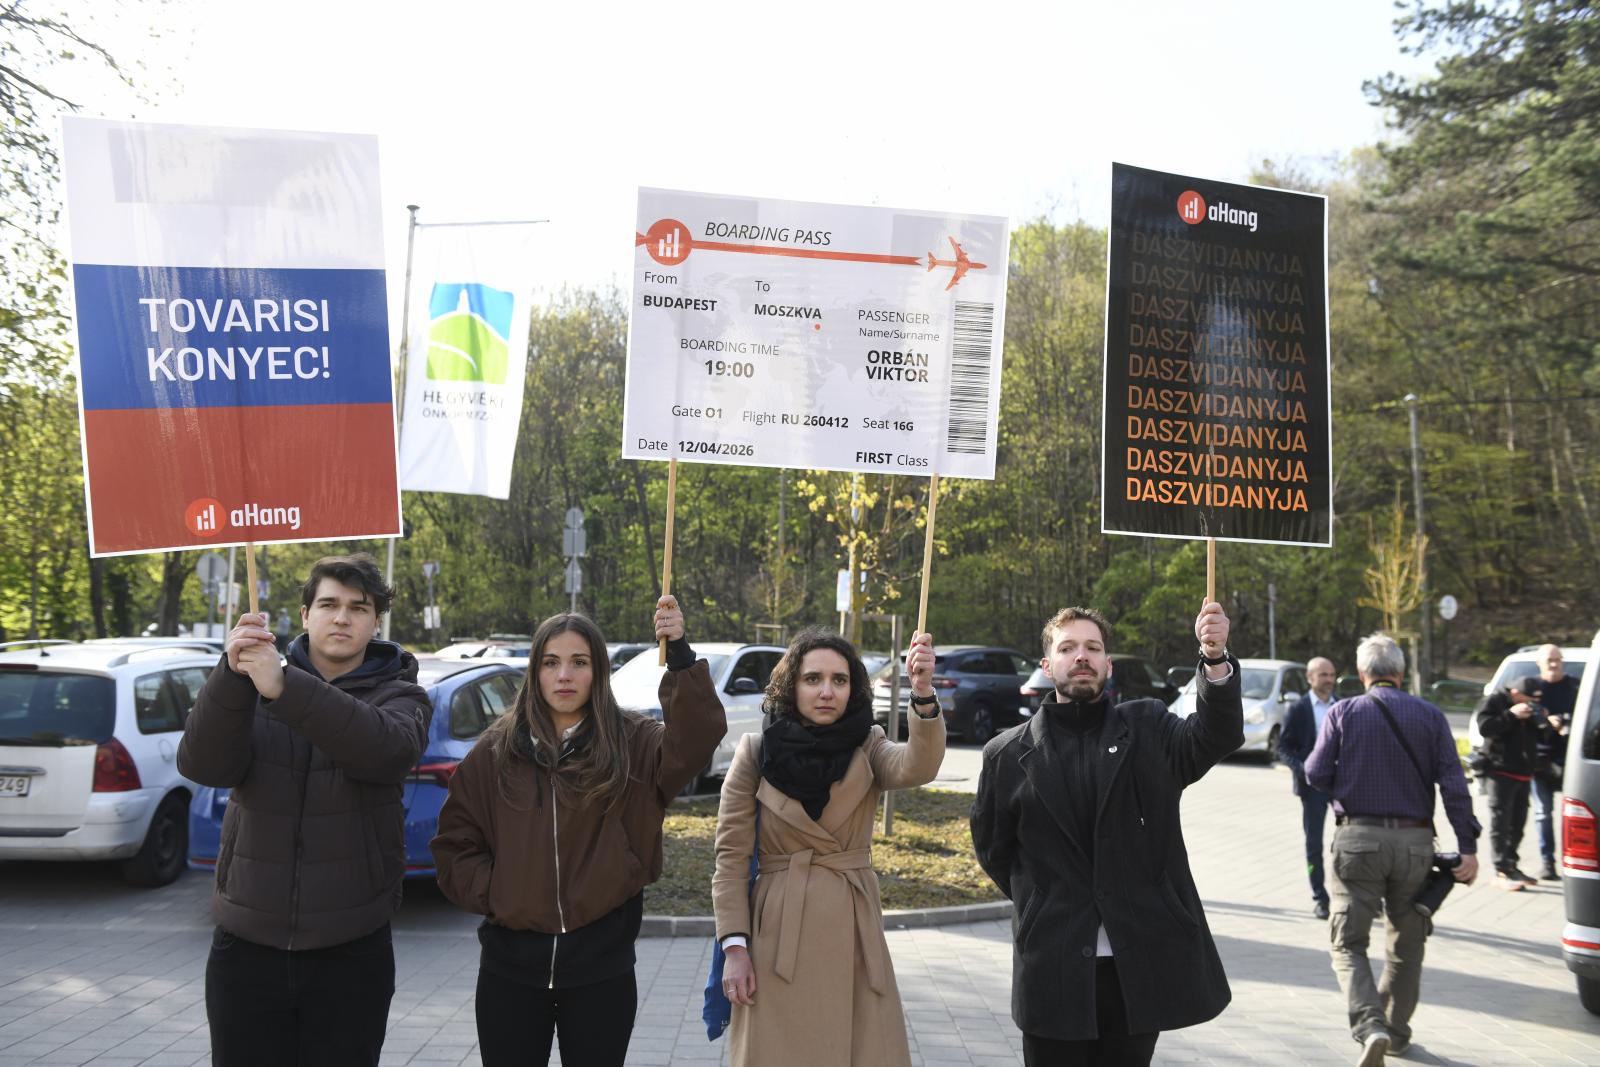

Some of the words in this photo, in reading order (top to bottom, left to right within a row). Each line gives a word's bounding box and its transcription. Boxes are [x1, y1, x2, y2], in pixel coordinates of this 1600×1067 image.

[1208, 202, 1258, 232] aHang
[704, 222, 790, 242] BOARDING
[794, 229, 832, 246] PASS
[644, 271, 677, 284] From
[755, 280, 771, 292] To
[1131, 262, 1305, 306] DASZVIDANYJA
[643, 295, 718, 311] BUDAPEST
[754, 303, 822, 319] MOSZKVA
[139, 298, 330, 332] TOVARISI
[858, 310, 930, 324] PASSENGER
[1130, 292, 1305, 334] DASZVIDANYJA
[859, 328, 940, 341] Name/Surname
[680, 338, 747, 353] BOARDING
[751, 344, 779, 356] TIME
[1129, 323, 1306, 365] DASZVIDANYJA
[147, 346, 330, 381] KONYEC!
[867, 349, 929, 367] ORBÁN
[705, 360, 755, 378] 19:00
[866, 365, 929, 383] VIKTOR
[1128, 353, 1307, 393] DASZVIDANYJA
[671, 405, 702, 418] Gate
[1127, 385, 1308, 423] DASZVIDANYJA
[743, 411, 776, 426] Flight
[781, 414, 800, 425] RU
[803, 415, 849, 428] 260412
[863, 418, 890, 430] Seat
[893, 421, 914, 432] 16G
[1127, 415, 1308, 453] DASZVIDANYJA
[638, 438, 668, 450] Date
[678, 441, 754, 456] 12/04/2026
[856, 452, 892, 464] FIRST
[897, 454, 928, 467] Class
[1127, 447, 1308, 483] DASZVIDANYJA
[1126, 477, 1309, 512] DASZVIDANYJA
[230, 503, 301, 530] aHang
